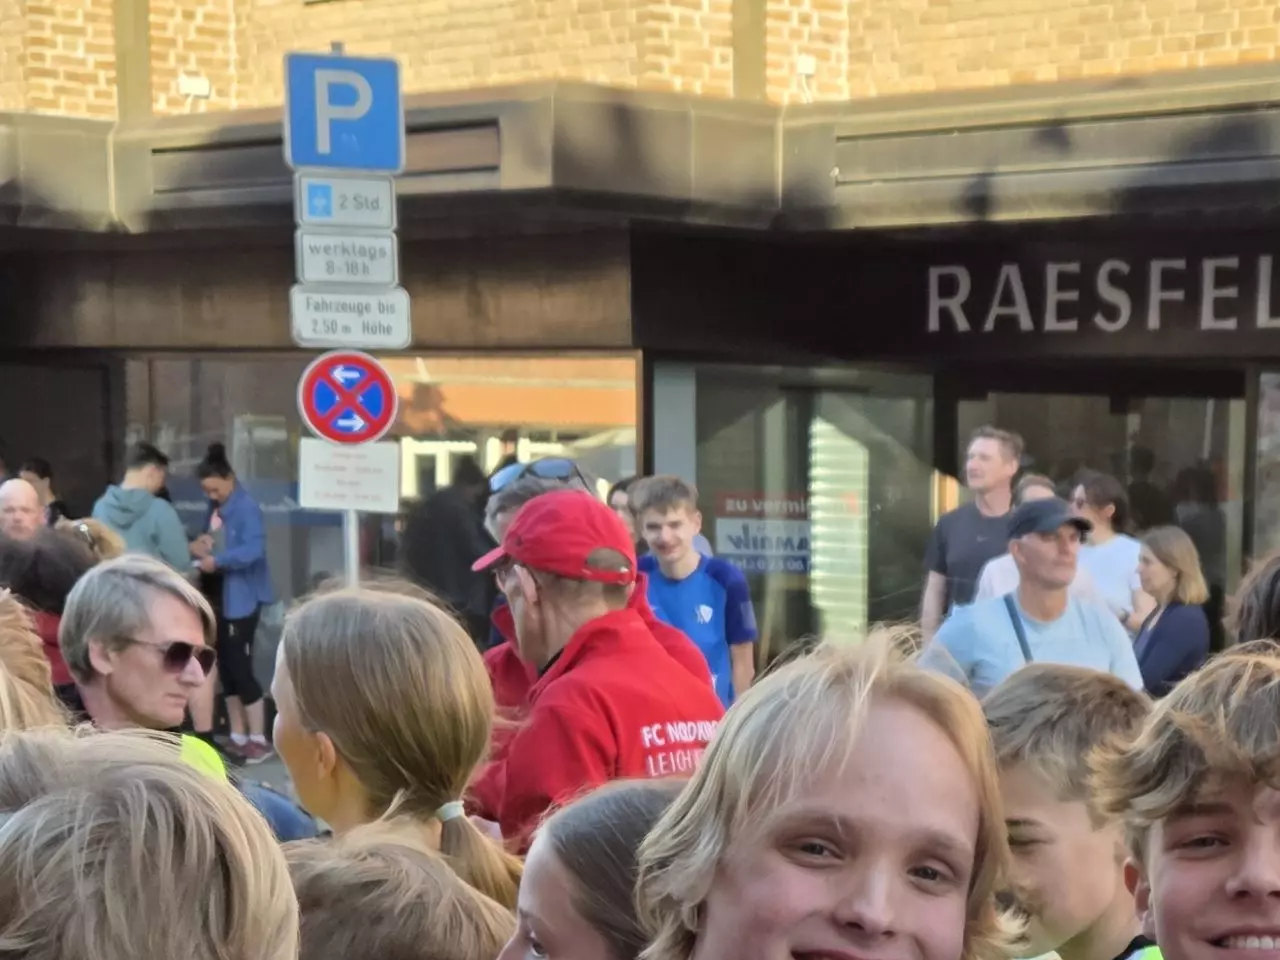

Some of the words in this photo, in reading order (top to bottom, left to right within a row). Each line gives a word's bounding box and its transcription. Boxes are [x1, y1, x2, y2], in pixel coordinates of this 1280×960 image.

[314, 69, 373, 155] P
[339, 194, 348, 210] 2
[309, 241, 387, 261] werktags
[306, 296, 371, 317] Fahrzeuge
[378, 300, 396, 315] bis
[362, 320, 393, 336] Höhe
[641, 723, 665, 748] FC
